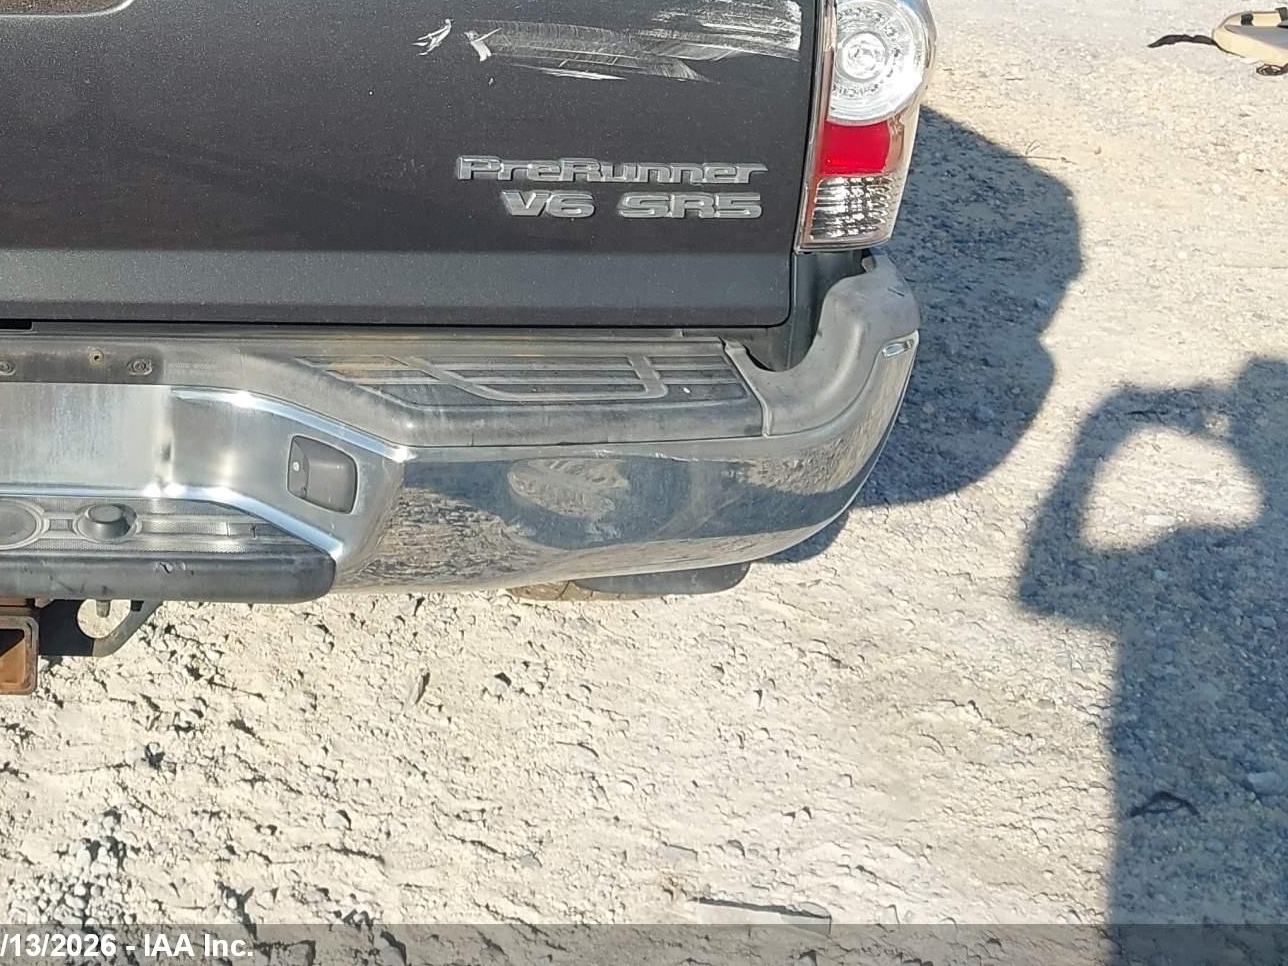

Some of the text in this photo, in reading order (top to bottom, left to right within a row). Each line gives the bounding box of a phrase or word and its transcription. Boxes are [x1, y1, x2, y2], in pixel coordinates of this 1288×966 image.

[457, 155, 769, 183] PreRunner
[500, 190, 763, 218] V6 SR5
